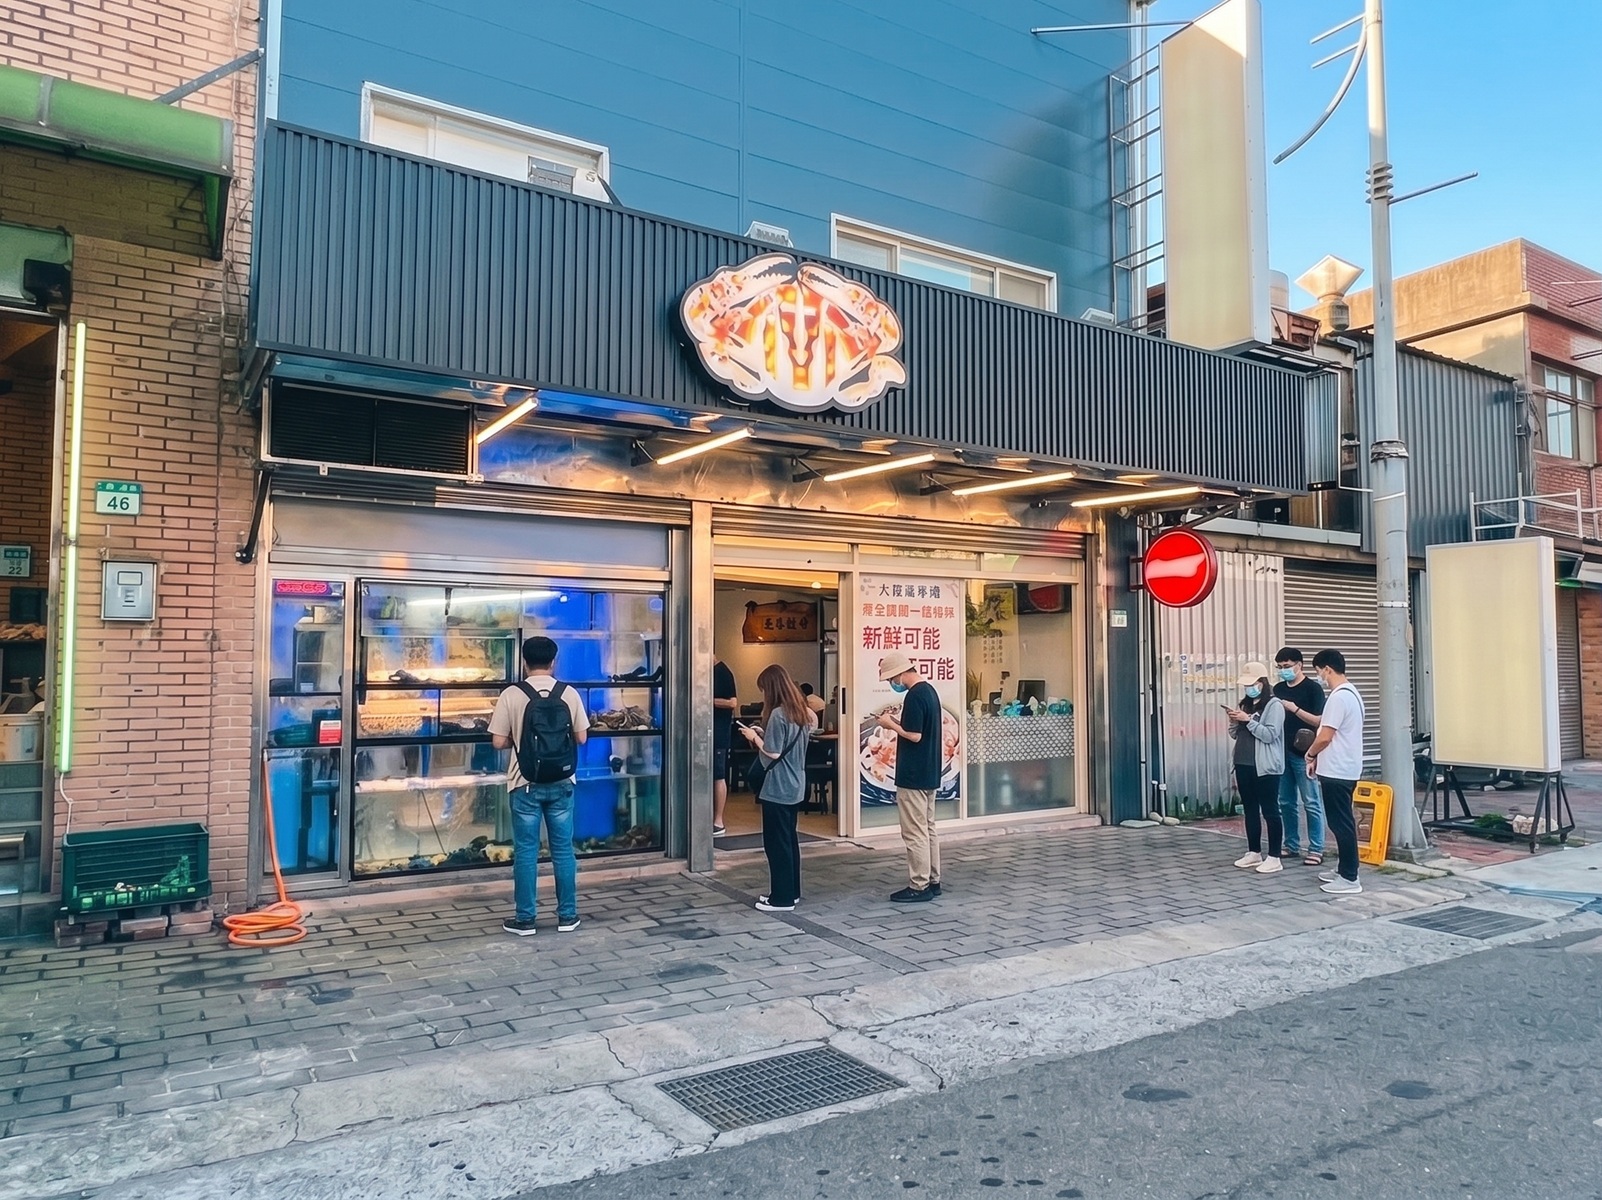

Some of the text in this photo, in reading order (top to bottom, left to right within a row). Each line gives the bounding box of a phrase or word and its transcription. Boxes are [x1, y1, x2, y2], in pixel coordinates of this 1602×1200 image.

[107, 496, 130, 511] 46
[8, 566, 23, 575] 22
[862, 625, 941, 650] 新鮮可能
